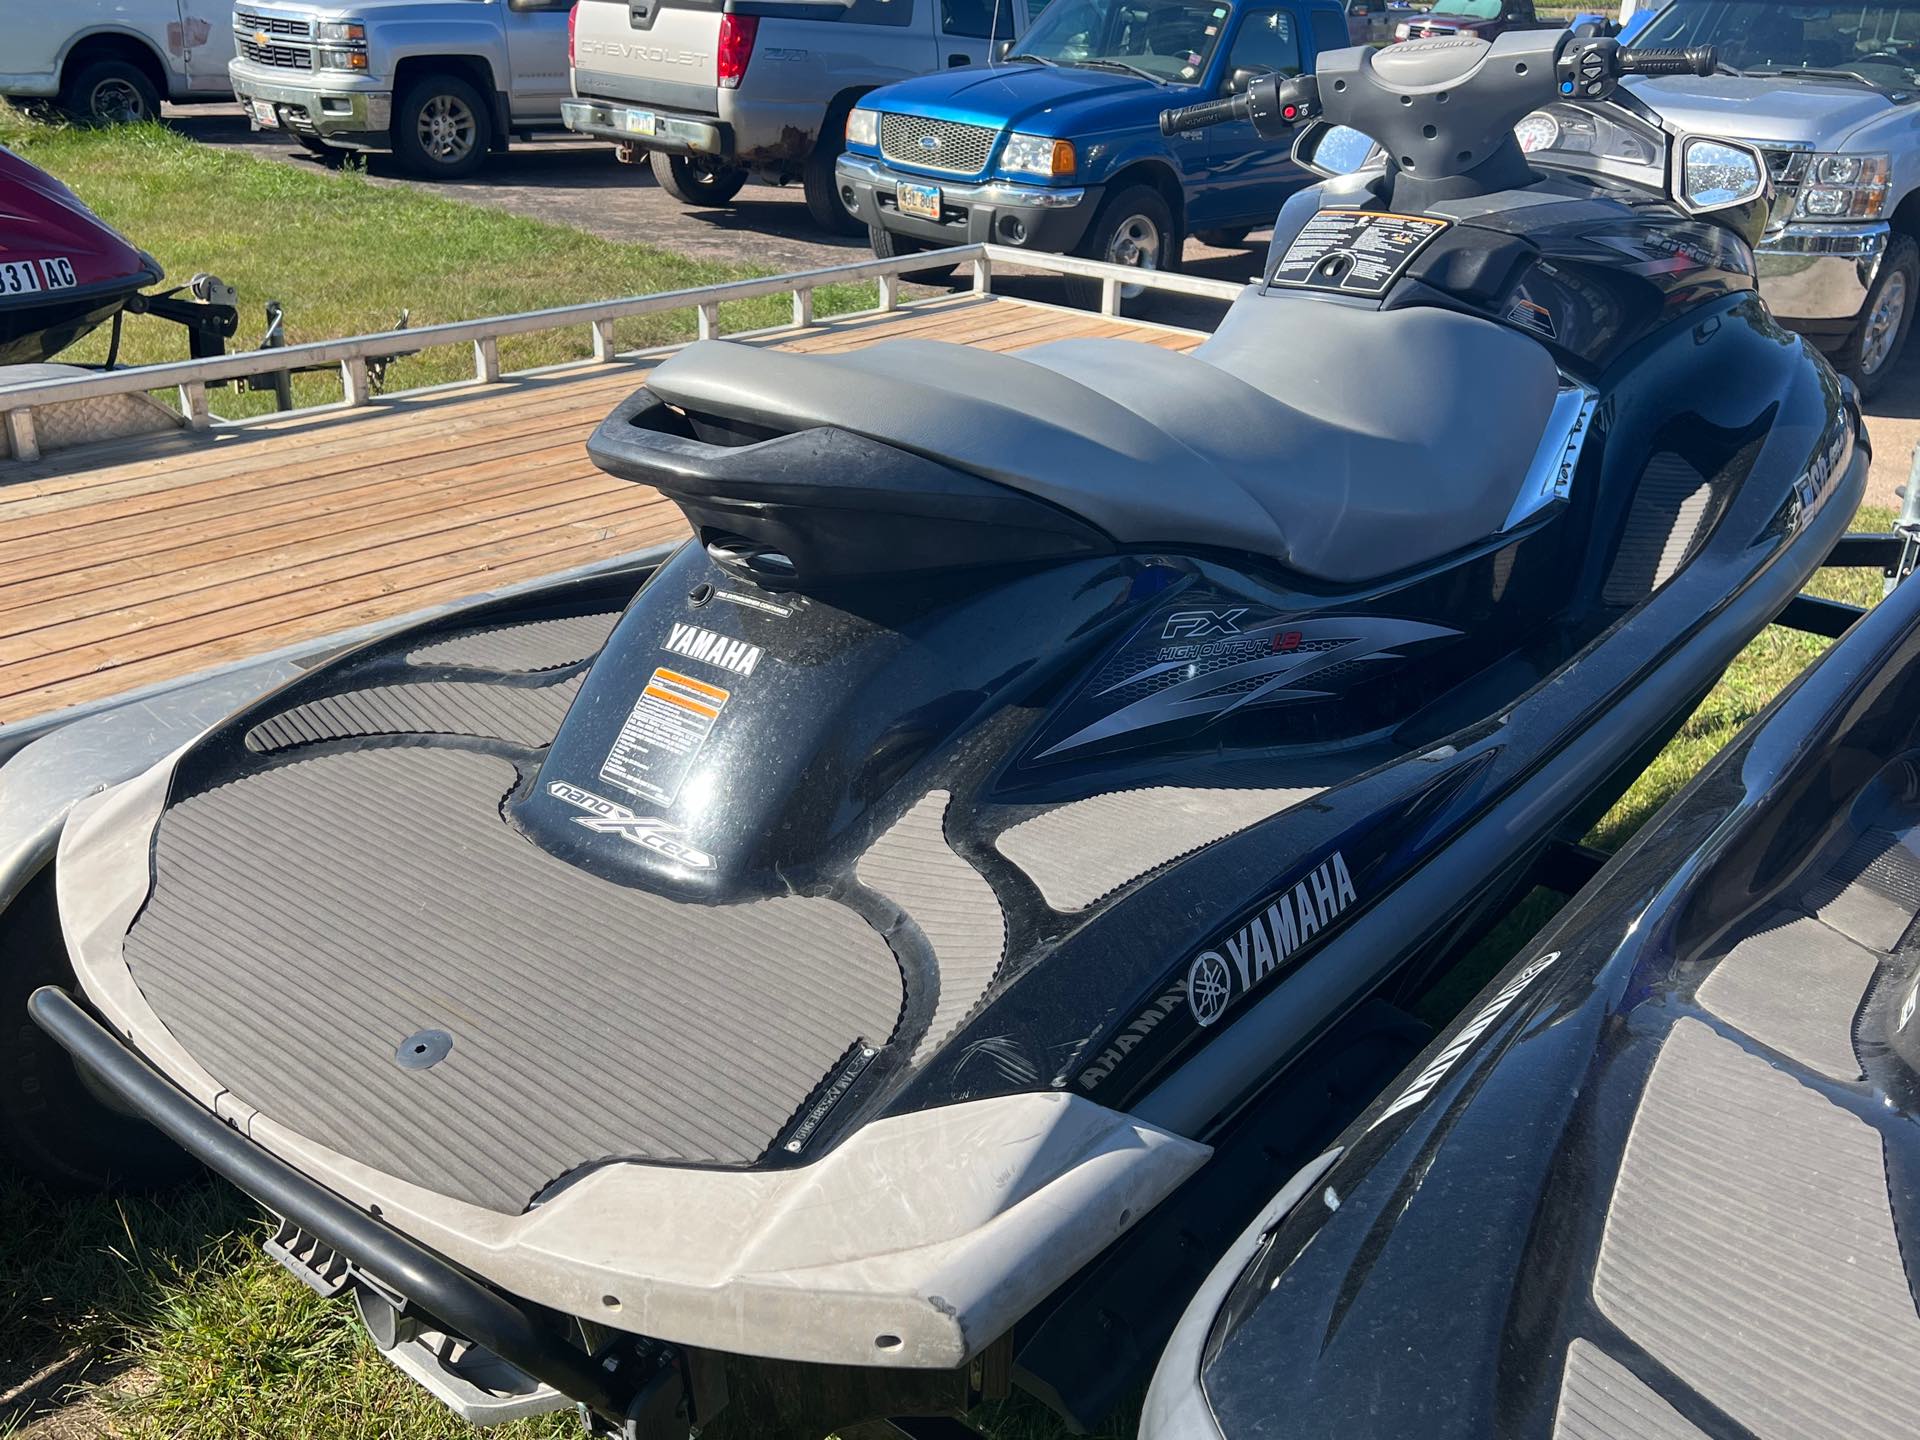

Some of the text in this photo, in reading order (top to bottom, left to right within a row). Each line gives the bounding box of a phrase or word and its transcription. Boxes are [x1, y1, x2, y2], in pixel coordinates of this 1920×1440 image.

[580, 40, 709, 67] CHEVROLET
[45, 259, 74, 288] AC
[1161, 608, 1249, 639] FX
[665, 622, 760, 677] YAMAHA
[1158, 645, 1200, 661] HIGH
[1200, 639, 1269, 657] OUTPUT
[1225, 851, 1357, 993] YAMAHA
